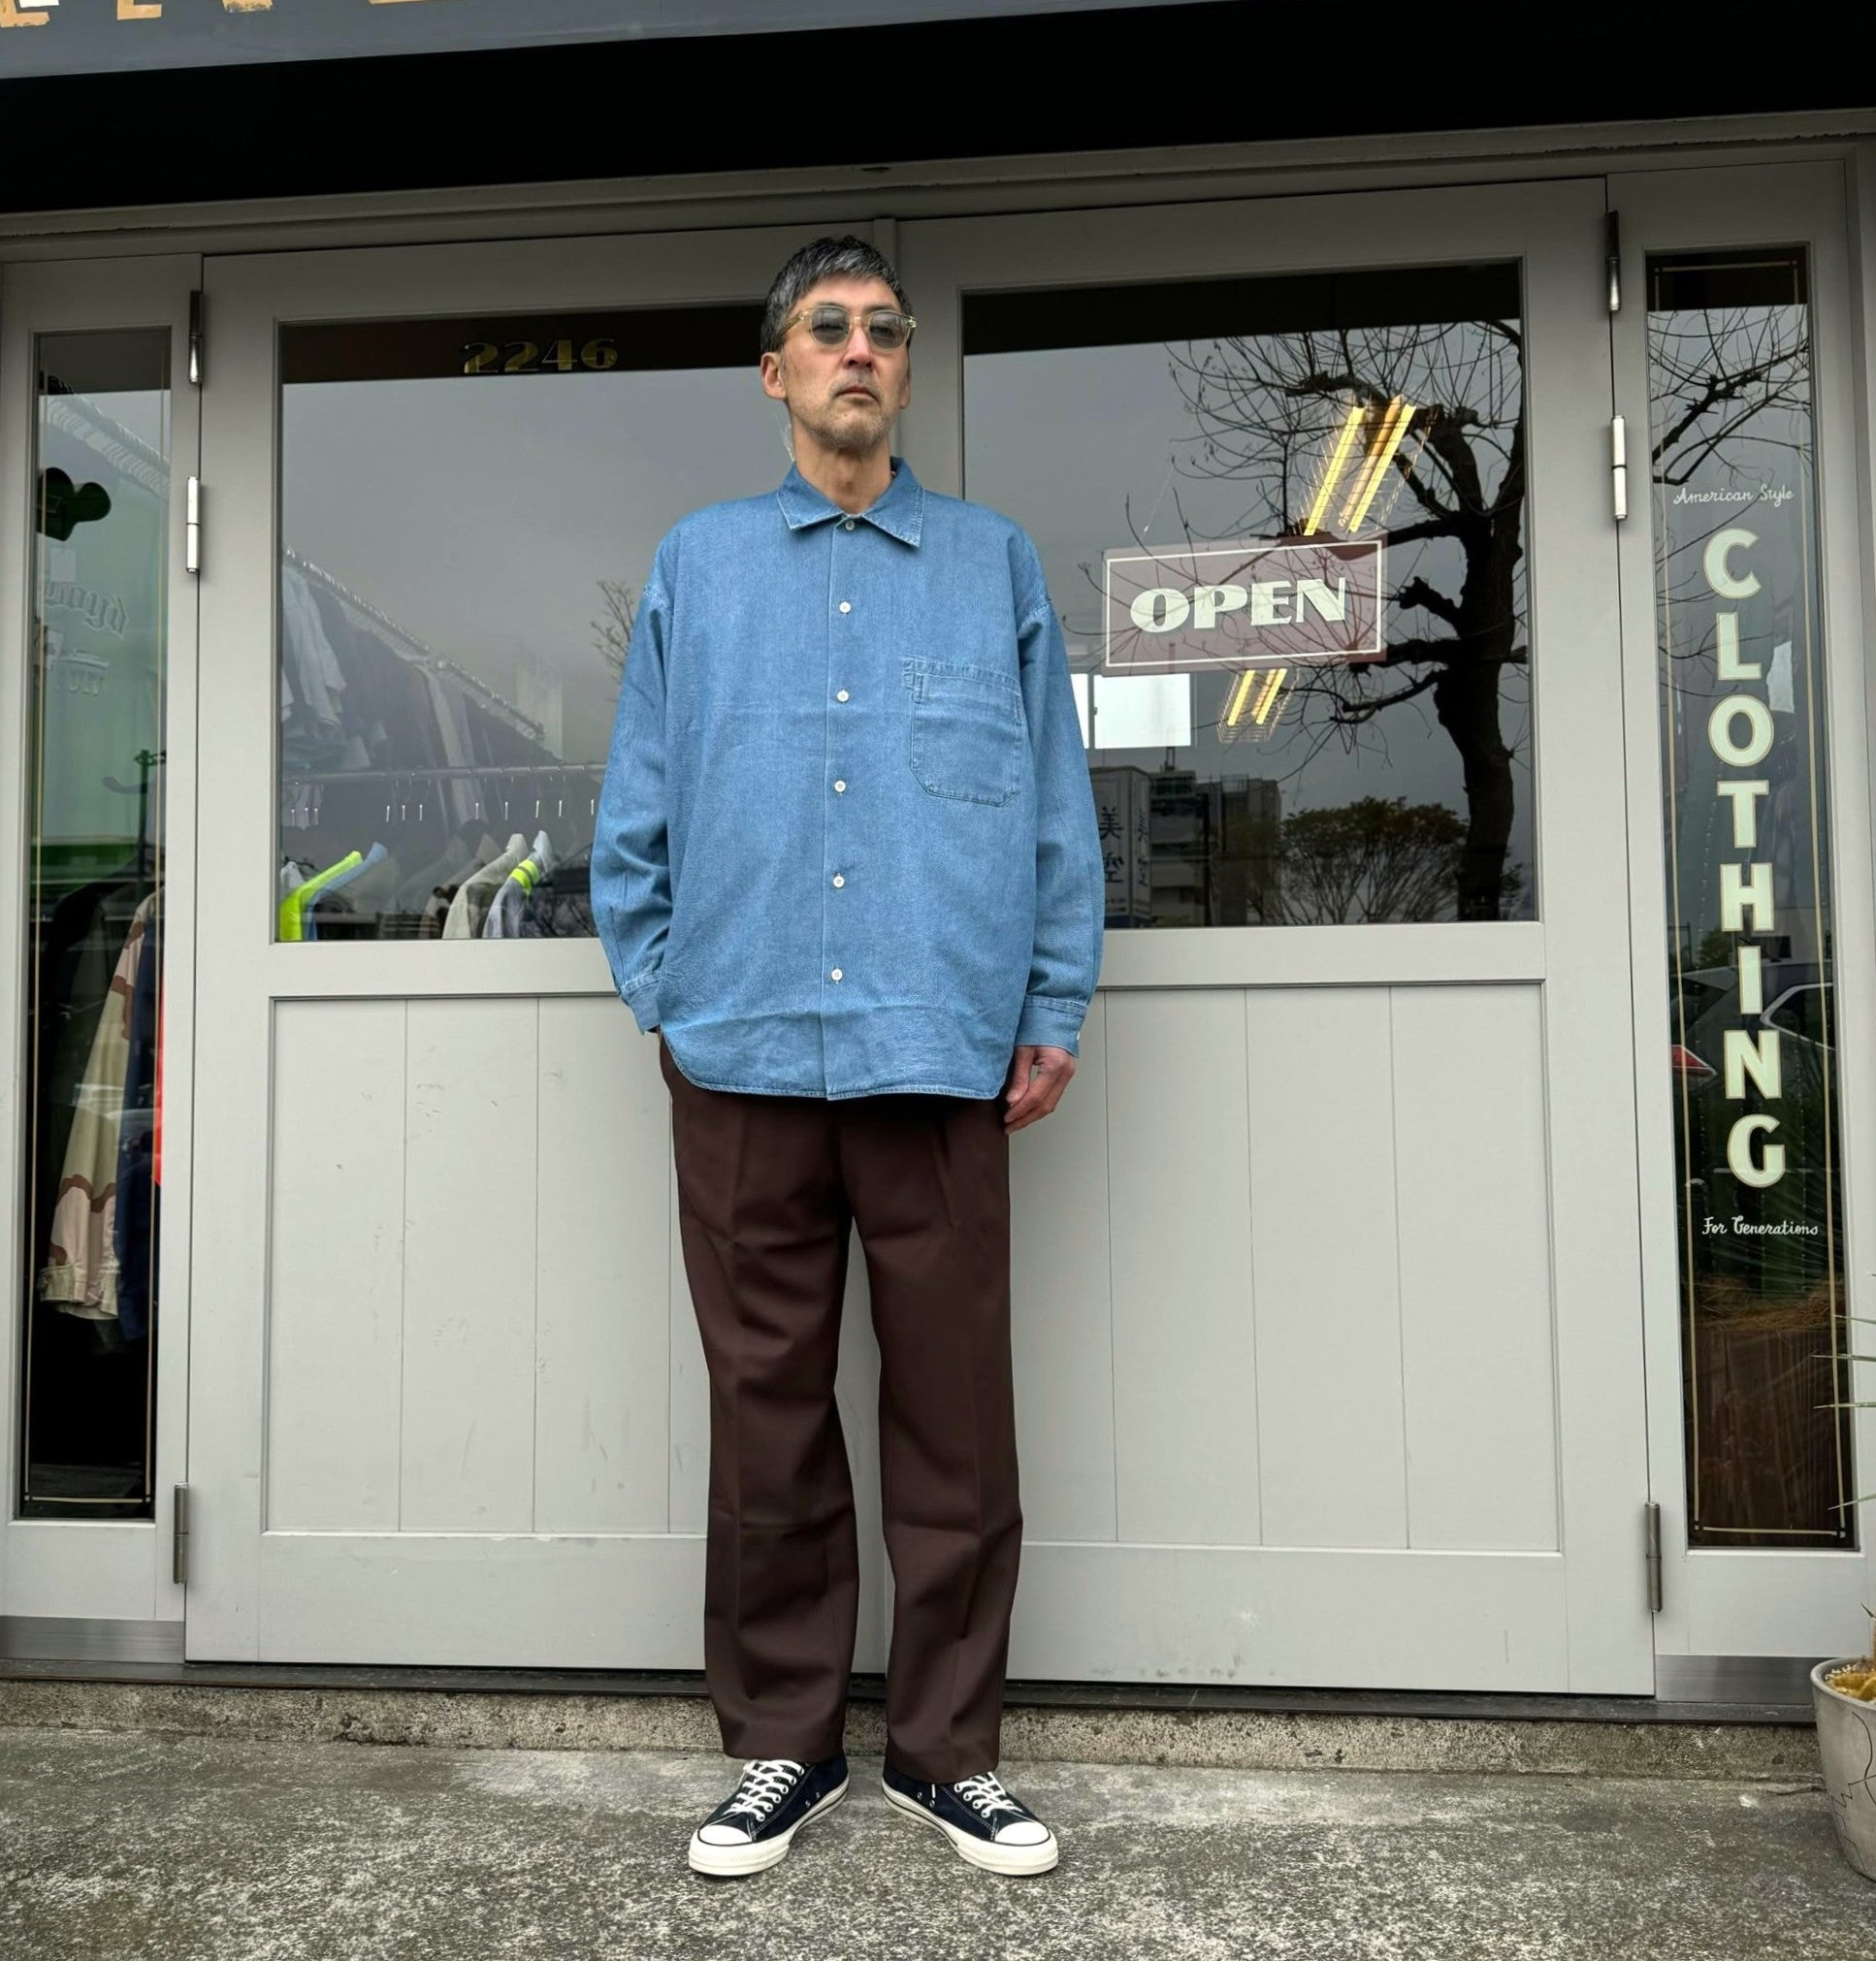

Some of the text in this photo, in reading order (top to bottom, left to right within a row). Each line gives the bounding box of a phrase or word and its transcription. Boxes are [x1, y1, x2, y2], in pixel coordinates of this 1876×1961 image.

[461, 338, 619, 374] 2246
[1673, 483, 1795, 508] American Style
[1130, 576, 1347, 633] OPEN
[1703, 528, 1787, 1189] CLOTHING
[1701, 1214, 1819, 1236] For Generations
